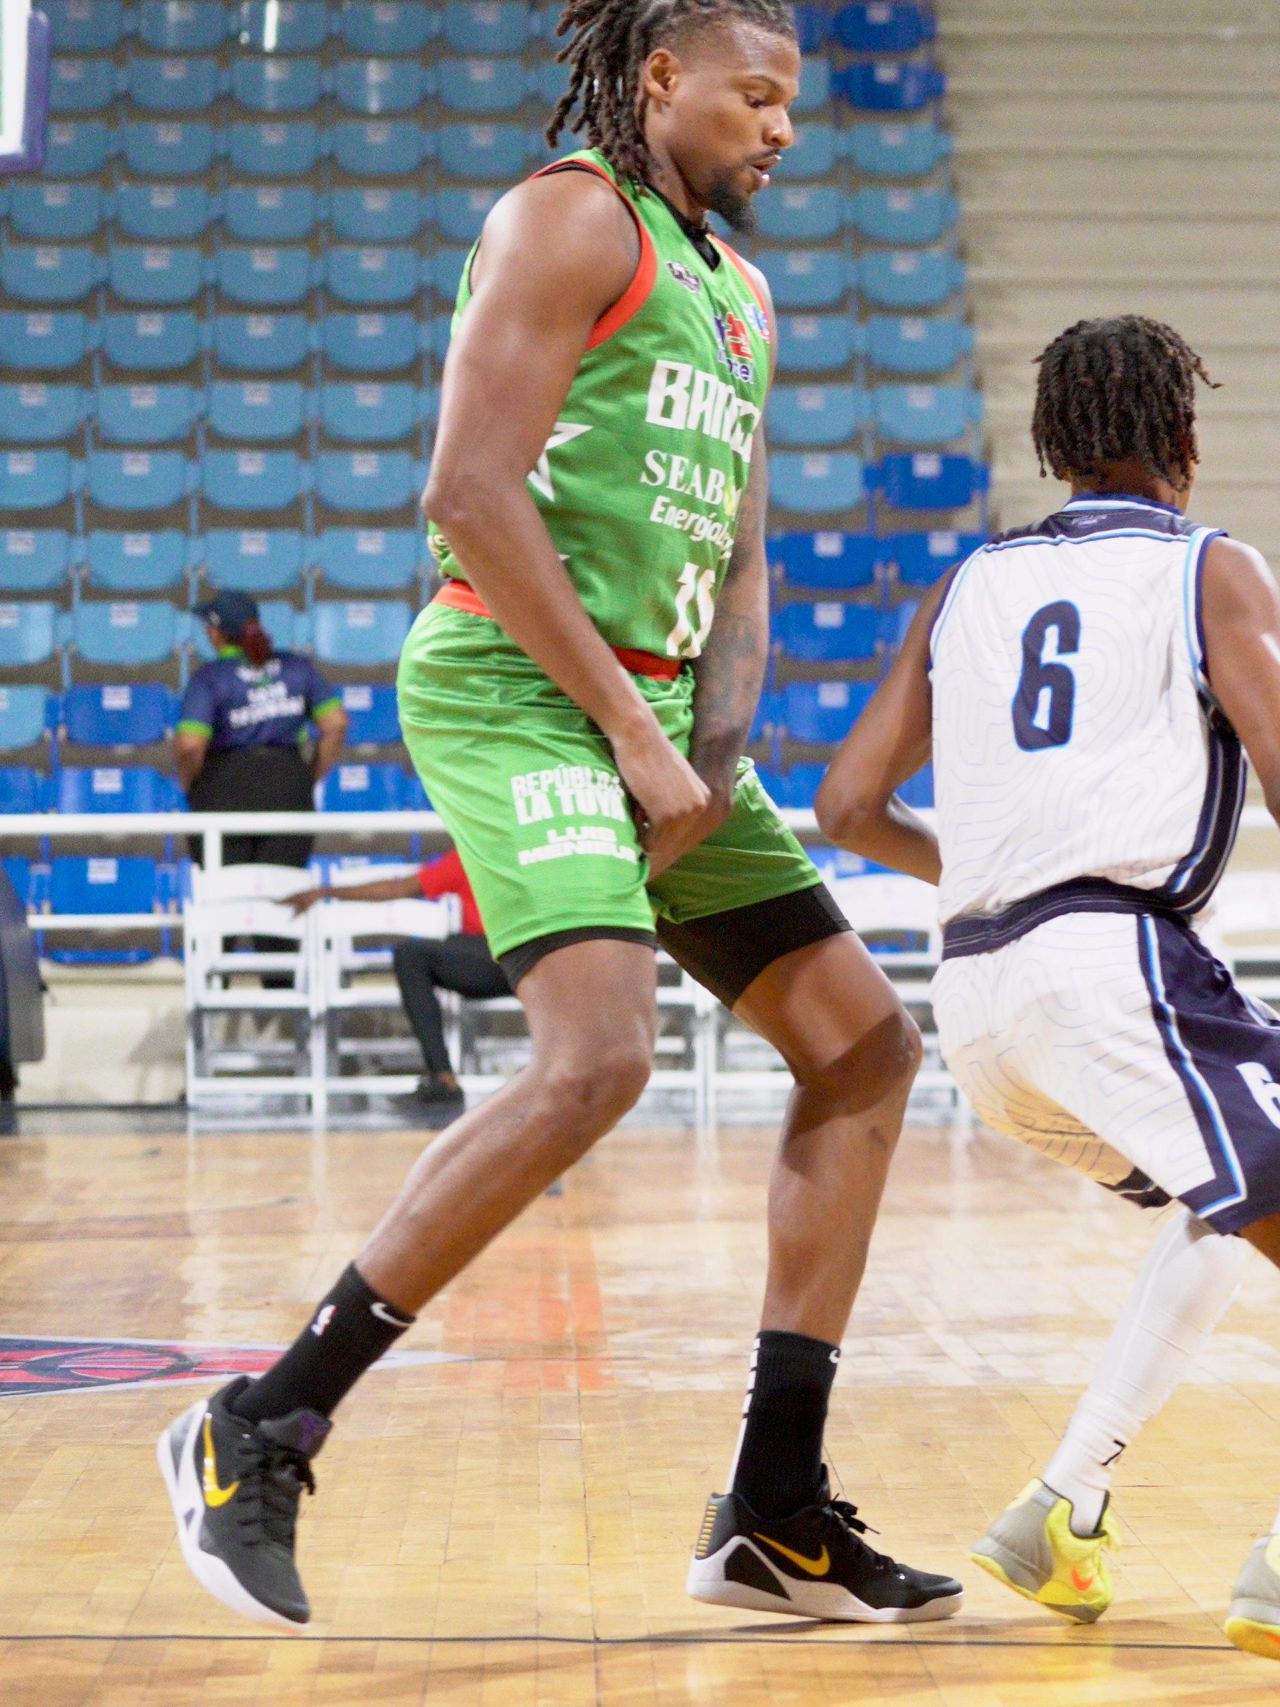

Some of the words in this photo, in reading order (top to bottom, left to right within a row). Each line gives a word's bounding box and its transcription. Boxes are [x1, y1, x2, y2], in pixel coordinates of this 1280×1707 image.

[1011, 598, 1082, 753] 6
[514, 792, 556, 825] LA
[554, 786, 627, 823] TUYA
